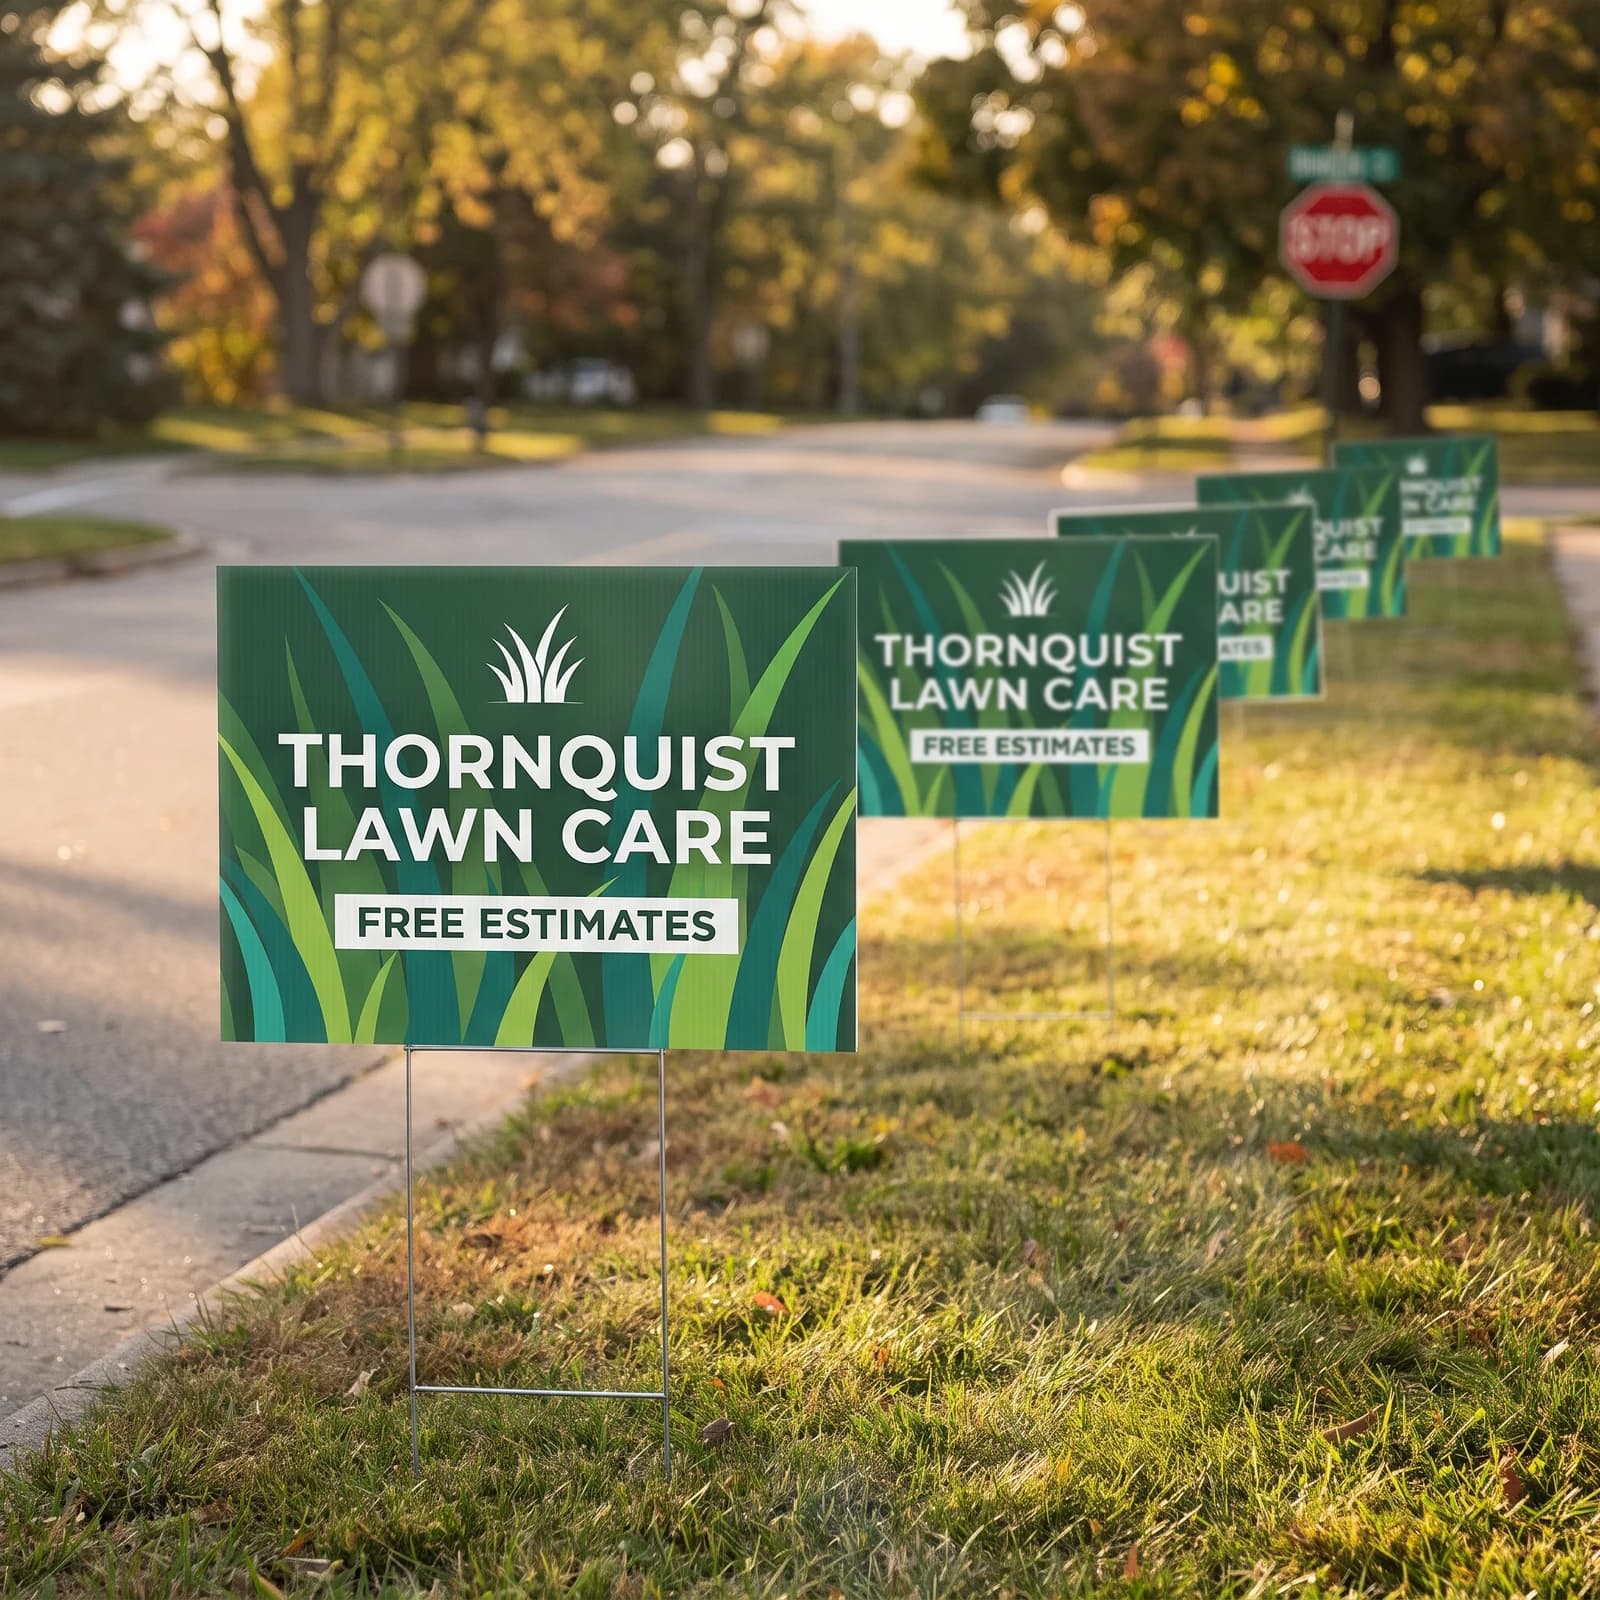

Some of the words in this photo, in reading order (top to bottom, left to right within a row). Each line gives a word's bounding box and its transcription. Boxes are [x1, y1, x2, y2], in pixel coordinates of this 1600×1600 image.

[1289, 213, 1389, 264] STOP
[874, 633, 1183, 674] THORNQUIST
[890, 677, 1028, 711] LAWN
[1043, 677, 1169, 711] CARE
[922, 736, 988, 756] FREE
[994, 736, 1136, 757] ESTIMATES
[277, 733, 796, 802] THORNQUIST
[303, 806, 533, 863] LAWN
[561, 808, 772, 865] CARE
[357, 906, 465, 939] FREE
[479, 908, 717, 942] ESTIMATES
